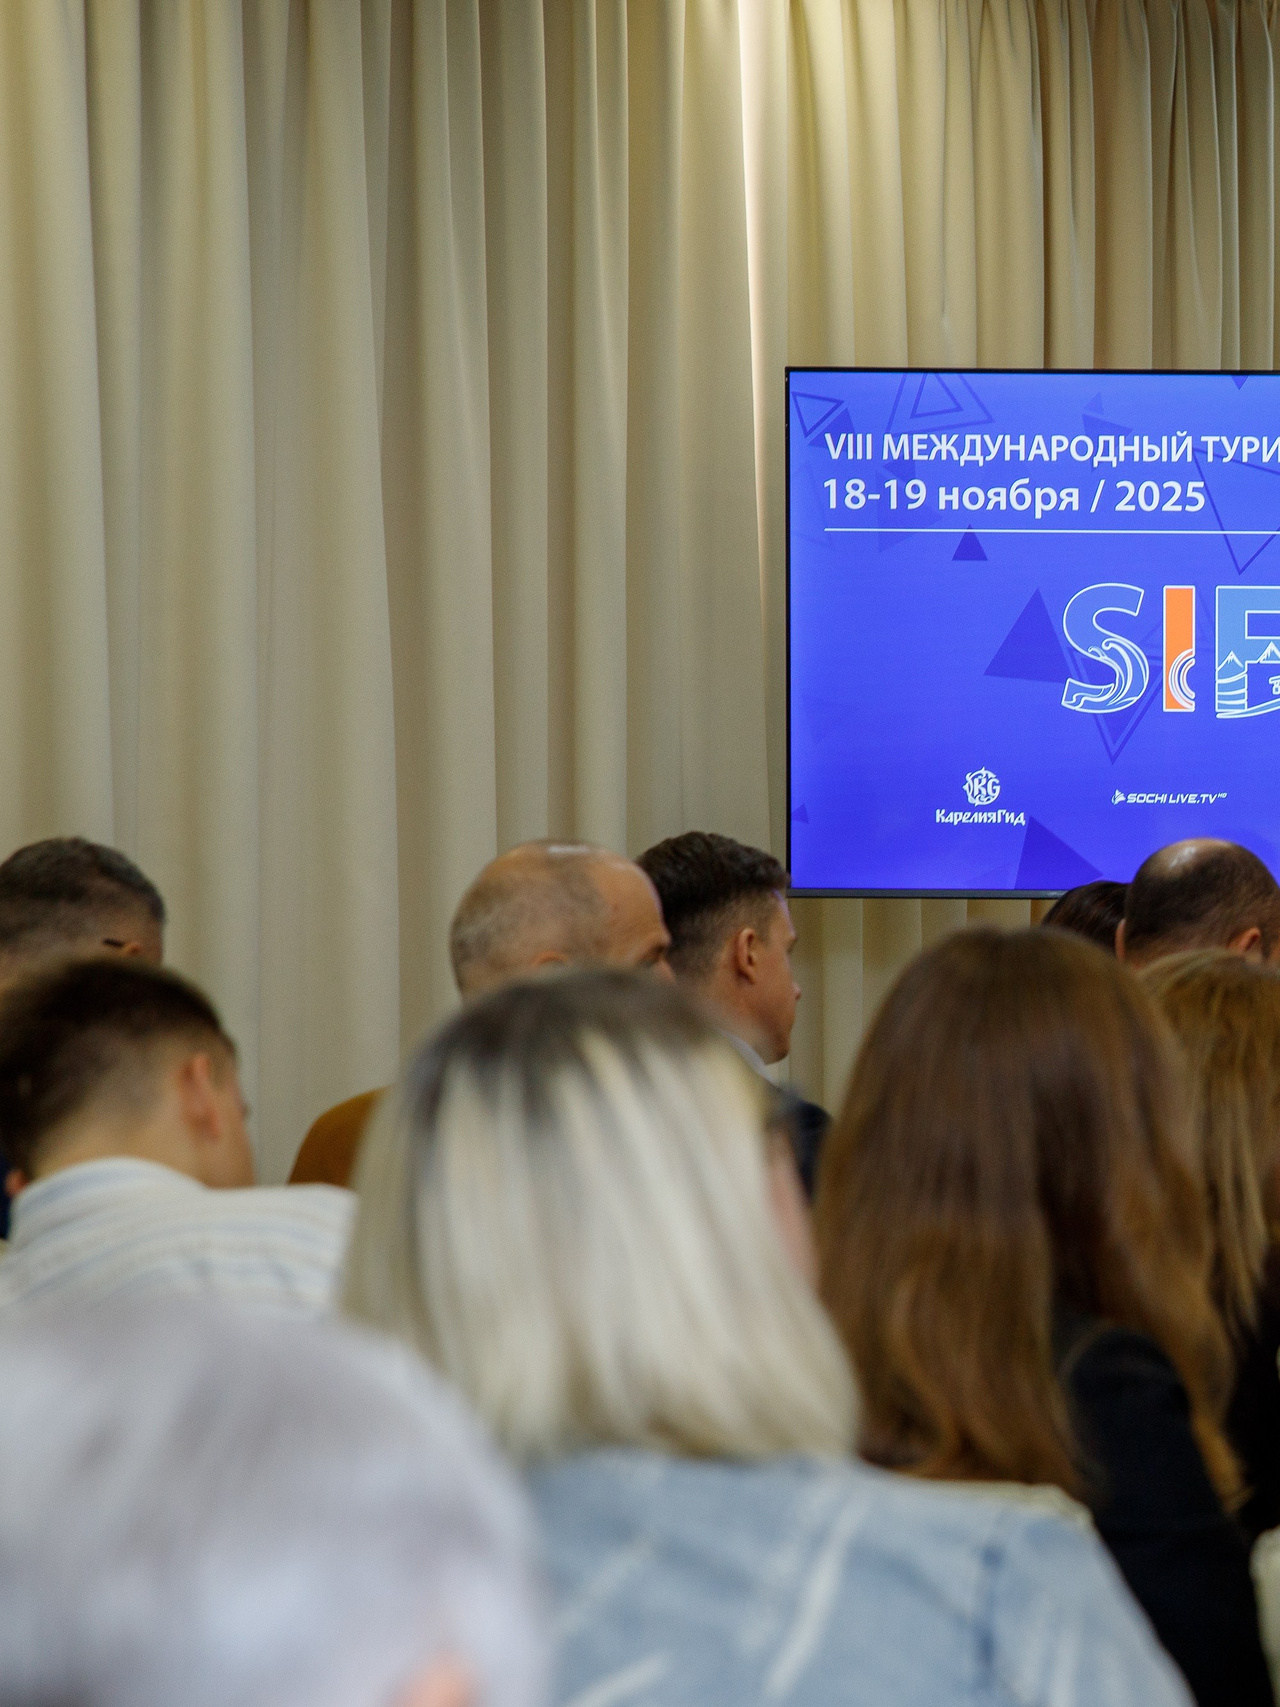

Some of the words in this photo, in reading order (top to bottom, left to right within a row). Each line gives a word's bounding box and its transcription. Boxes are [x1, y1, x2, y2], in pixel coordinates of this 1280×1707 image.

[824, 433, 873, 460] VIII
[882, 430, 1193, 468] МЕЖДУНАРОДНЫЙ
[823, 478, 927, 510] 18-19
[938, 477, 1079, 519] ноября
[1115, 480, 1206, 512] 2025
[1126, 793, 1167, 804] SOCHI
[1168, 793, 1217, 804] LIVE.TV
[935, 808, 1026, 826] КарелияГид
